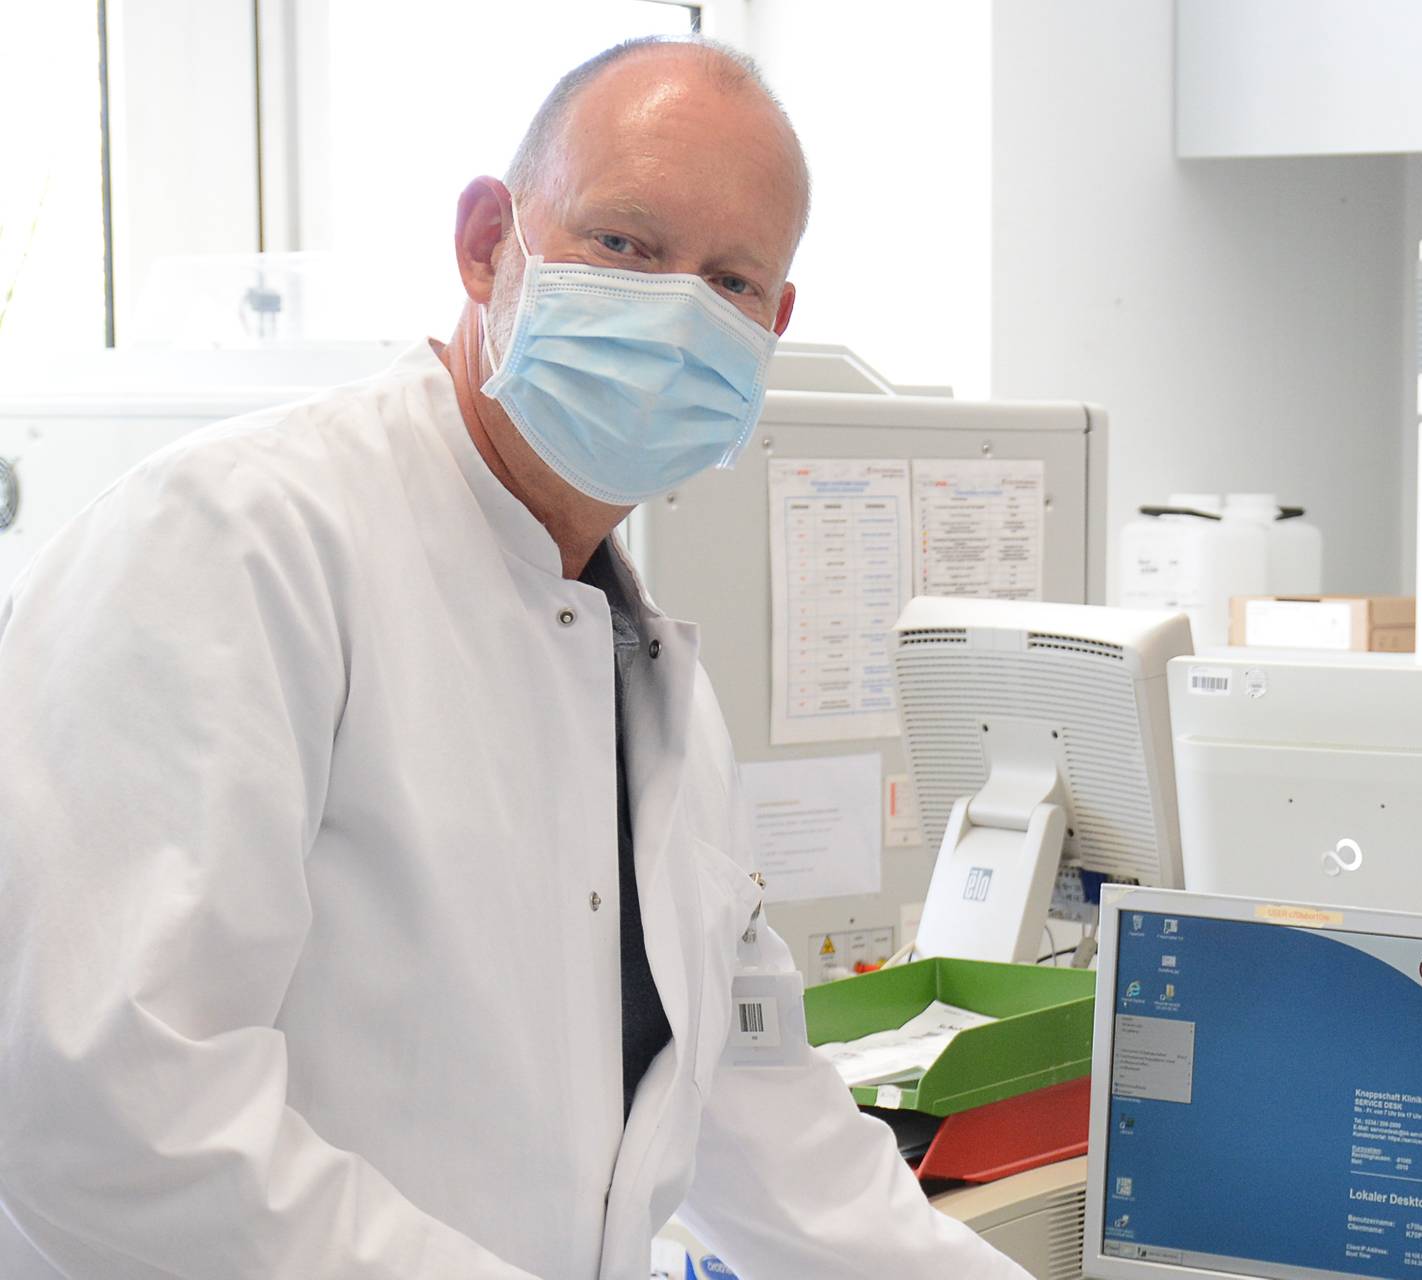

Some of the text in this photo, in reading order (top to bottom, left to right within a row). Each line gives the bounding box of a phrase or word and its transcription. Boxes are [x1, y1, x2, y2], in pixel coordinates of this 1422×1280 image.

[1354, 1098, 1403, 1110] SERVICE DESK
[1350, 1188, 1388, 1203] Lokaler
[1347, 1214, 1396, 1227] Benutzername:
